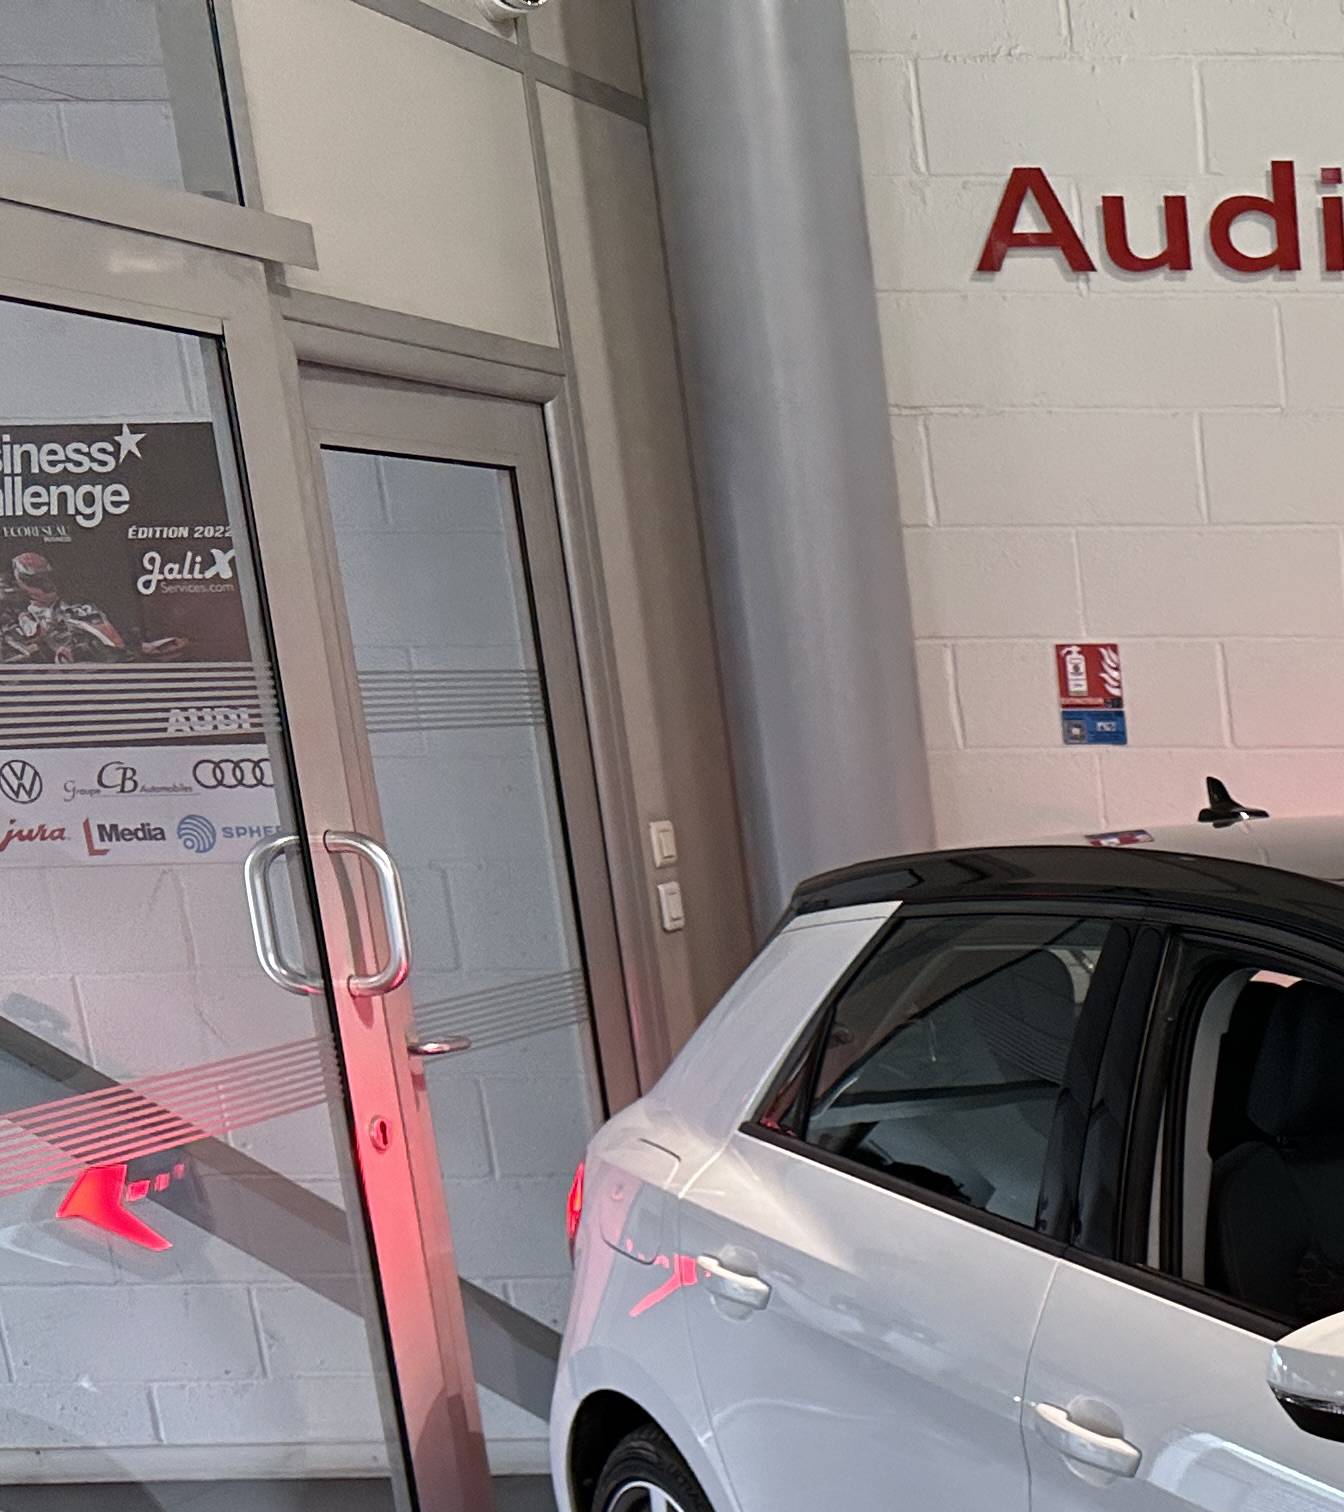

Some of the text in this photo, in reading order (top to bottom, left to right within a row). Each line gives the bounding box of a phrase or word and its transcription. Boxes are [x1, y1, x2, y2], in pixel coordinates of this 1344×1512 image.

[0, 434, 117, 474] iness
[0, 476, 130, 528] llenge
[127, 525, 189, 539] ÉDITION
[166, 708, 251, 733] AUDI
